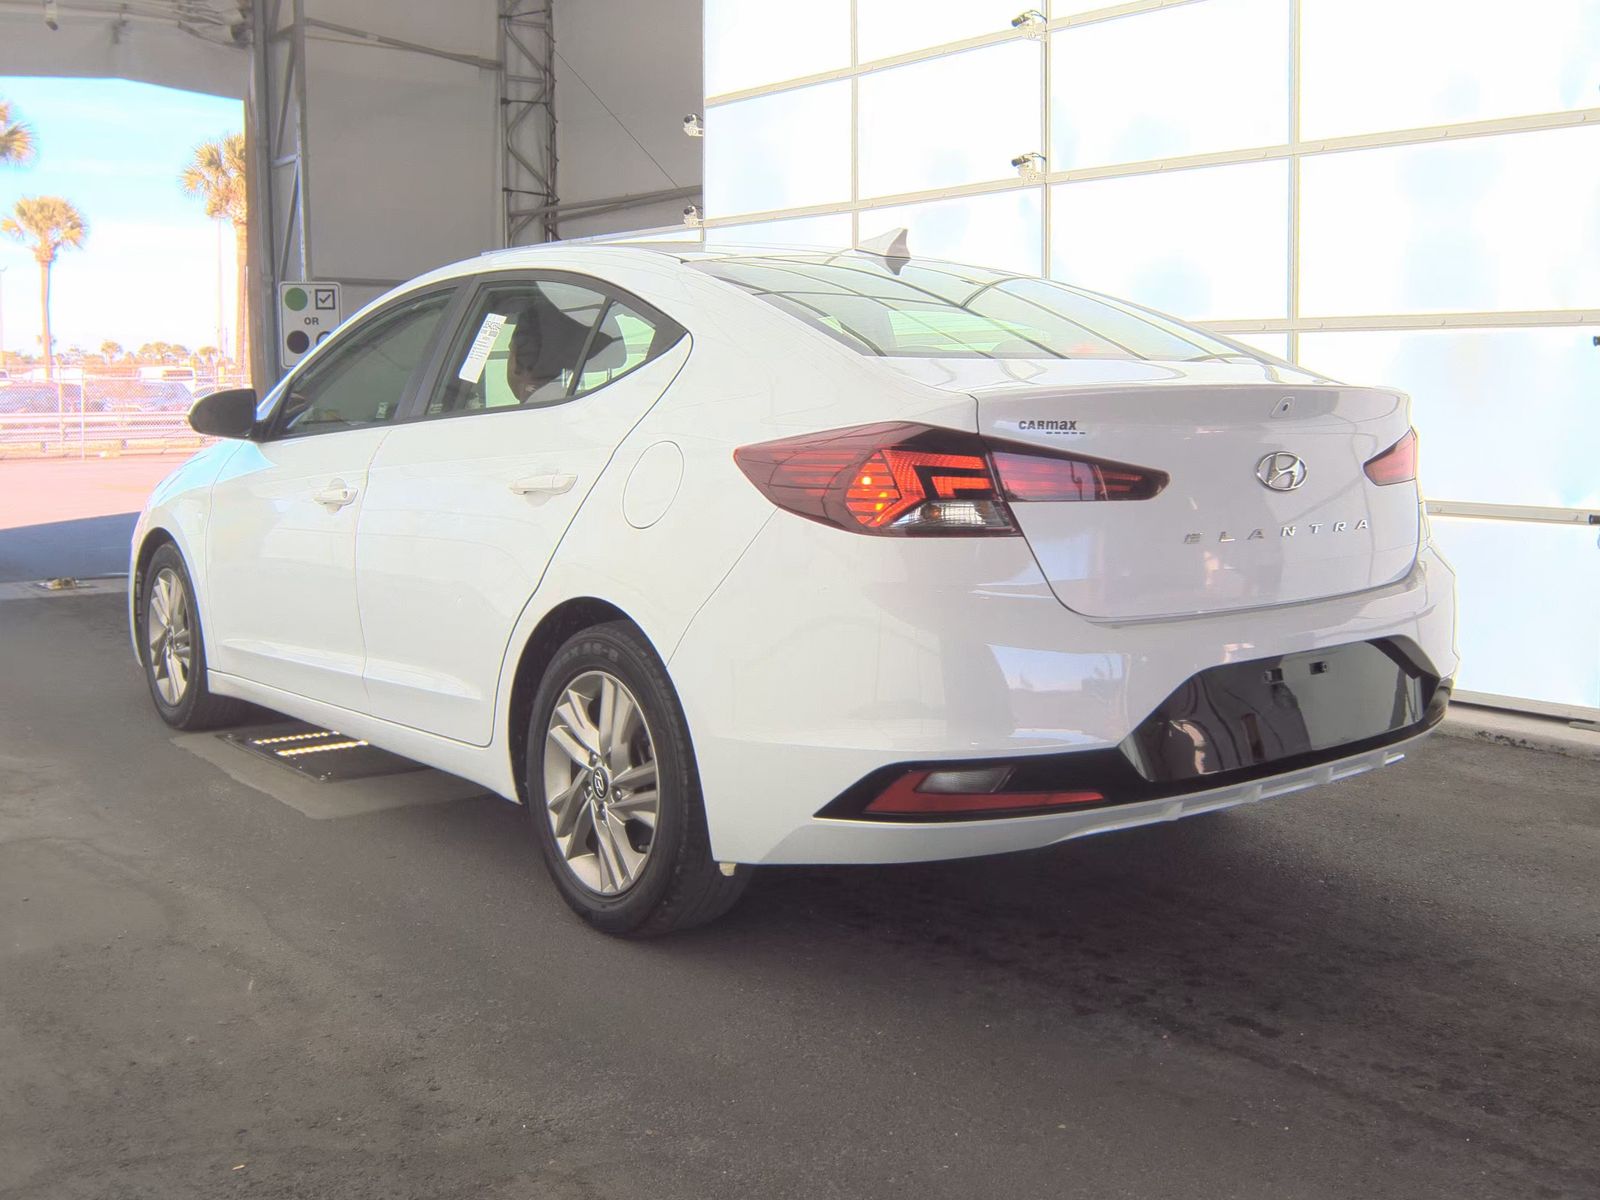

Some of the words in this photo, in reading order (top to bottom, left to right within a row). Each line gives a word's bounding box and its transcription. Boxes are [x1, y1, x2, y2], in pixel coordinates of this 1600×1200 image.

[303, 316, 320, 326] OR
[1018, 420, 1077, 431] CARmax
[1183, 518, 1370, 545] ELANTRA
